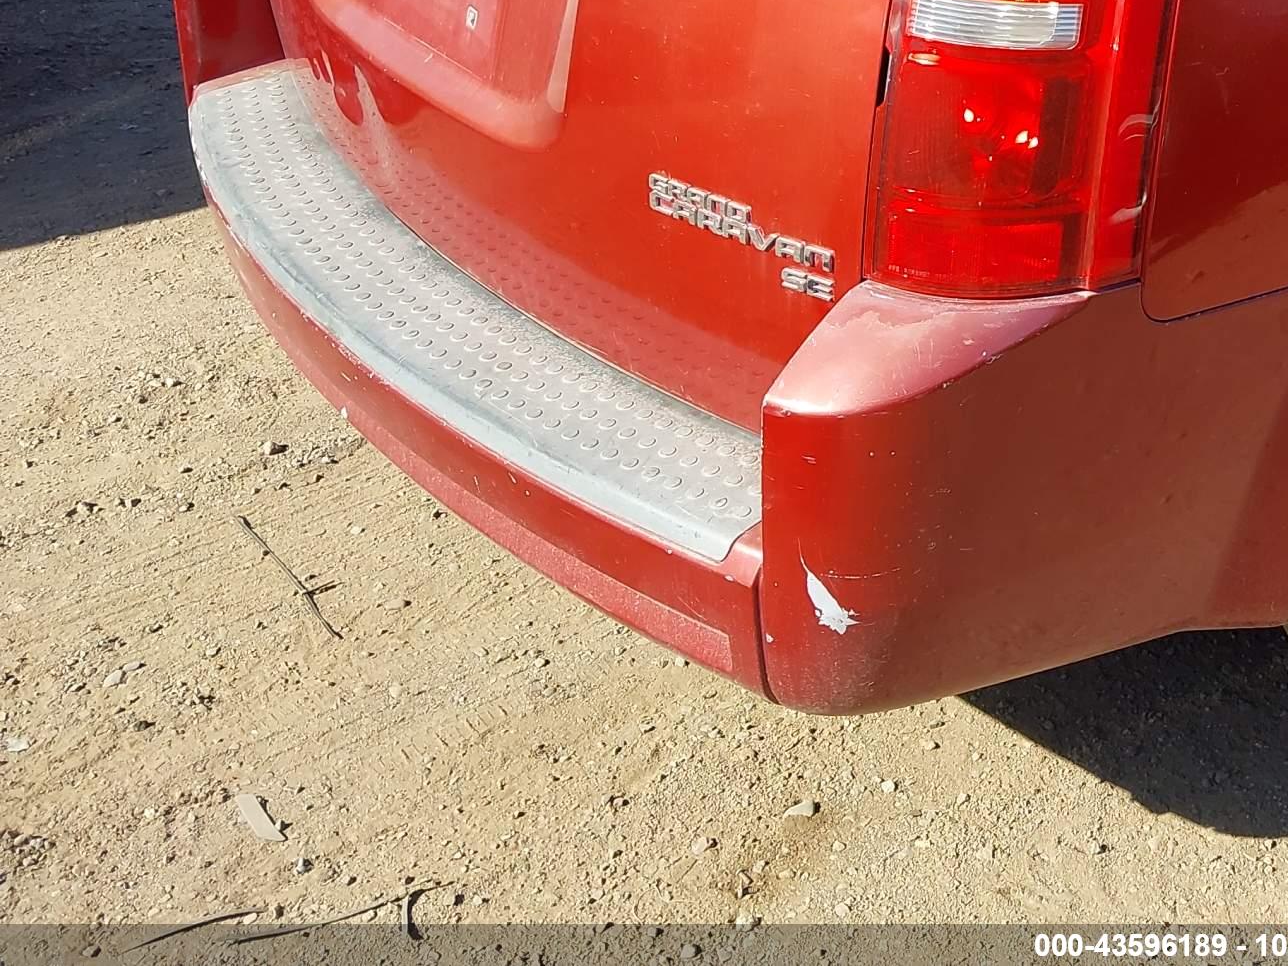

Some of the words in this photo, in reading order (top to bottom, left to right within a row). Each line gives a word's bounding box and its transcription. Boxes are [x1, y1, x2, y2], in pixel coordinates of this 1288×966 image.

[648, 172, 751, 223] GRAND
[648, 189, 835, 273] CARAVAN
[780, 266, 835, 302] SE
